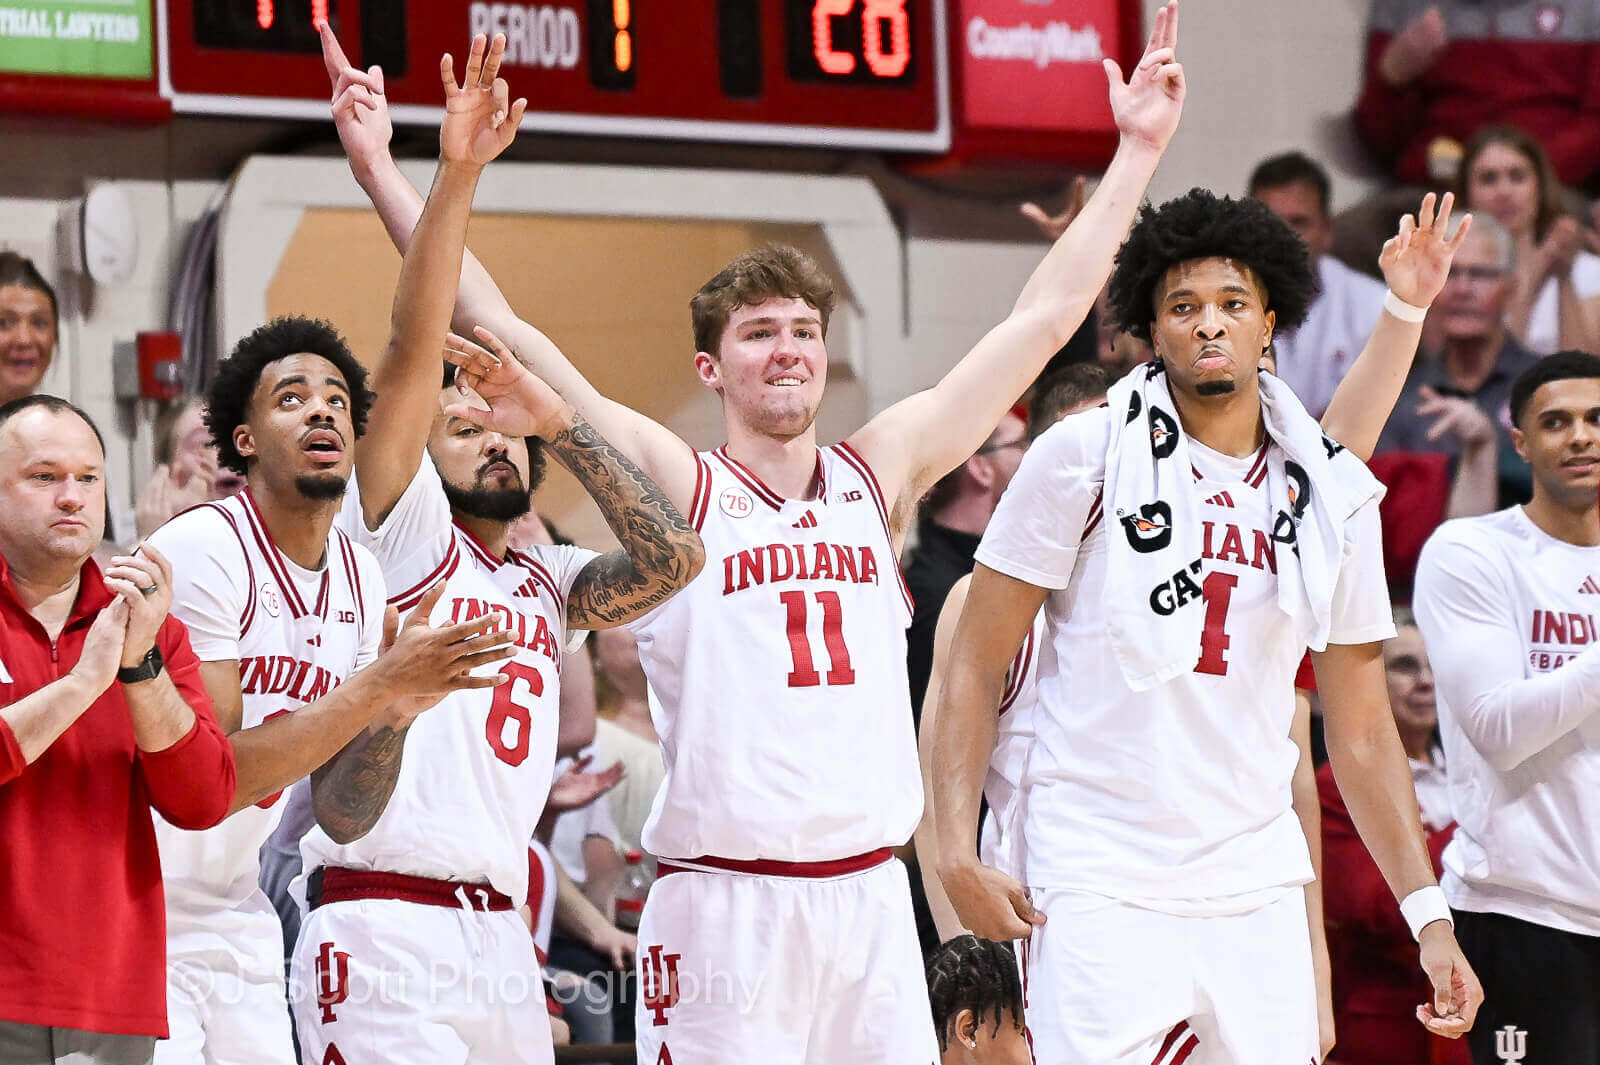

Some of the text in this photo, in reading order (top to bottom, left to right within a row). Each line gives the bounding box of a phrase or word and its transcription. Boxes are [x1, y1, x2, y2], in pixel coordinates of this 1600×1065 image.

[469, 2, 580, 70] PERIOD
[722, 542, 879, 596] INDIANA
[779, 591, 856, 688] 11
[485, 660, 545, 767] 6
